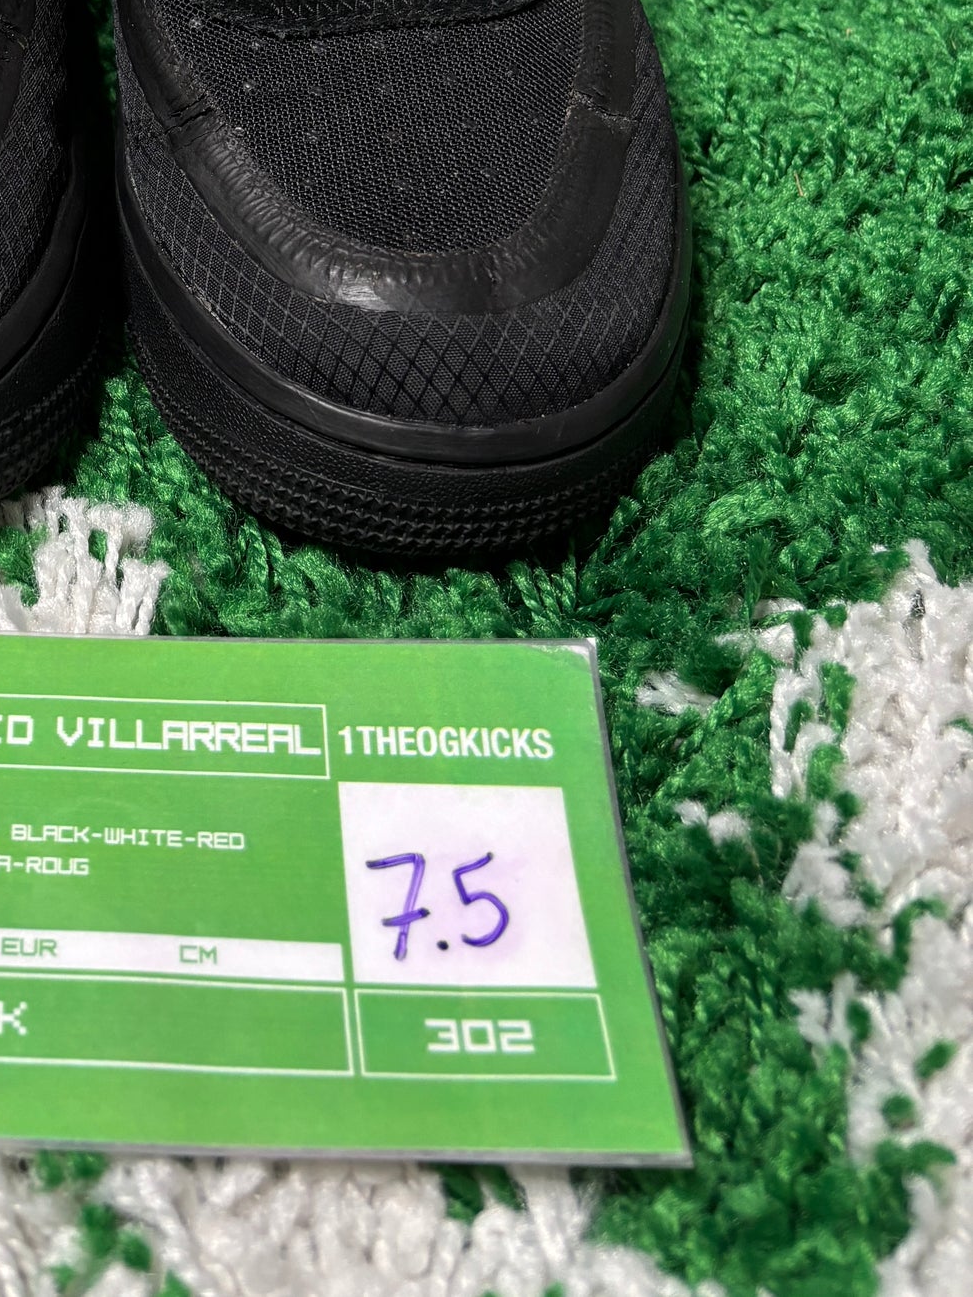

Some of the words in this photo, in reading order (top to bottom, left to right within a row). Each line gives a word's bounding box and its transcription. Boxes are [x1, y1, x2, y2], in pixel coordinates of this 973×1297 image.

[57, 716, 322, 756] VILLARREAL
[338, 726, 554, 760] 1THEOGKICKS
[11, 824, 246, 851] BLACK-WHITE-RED
[366, 852, 509, 961] 7.5
[0, 937, 58, 958] EUR
[180, 944, 218, 965] CM
[424, 1018, 535, 1053] 302
